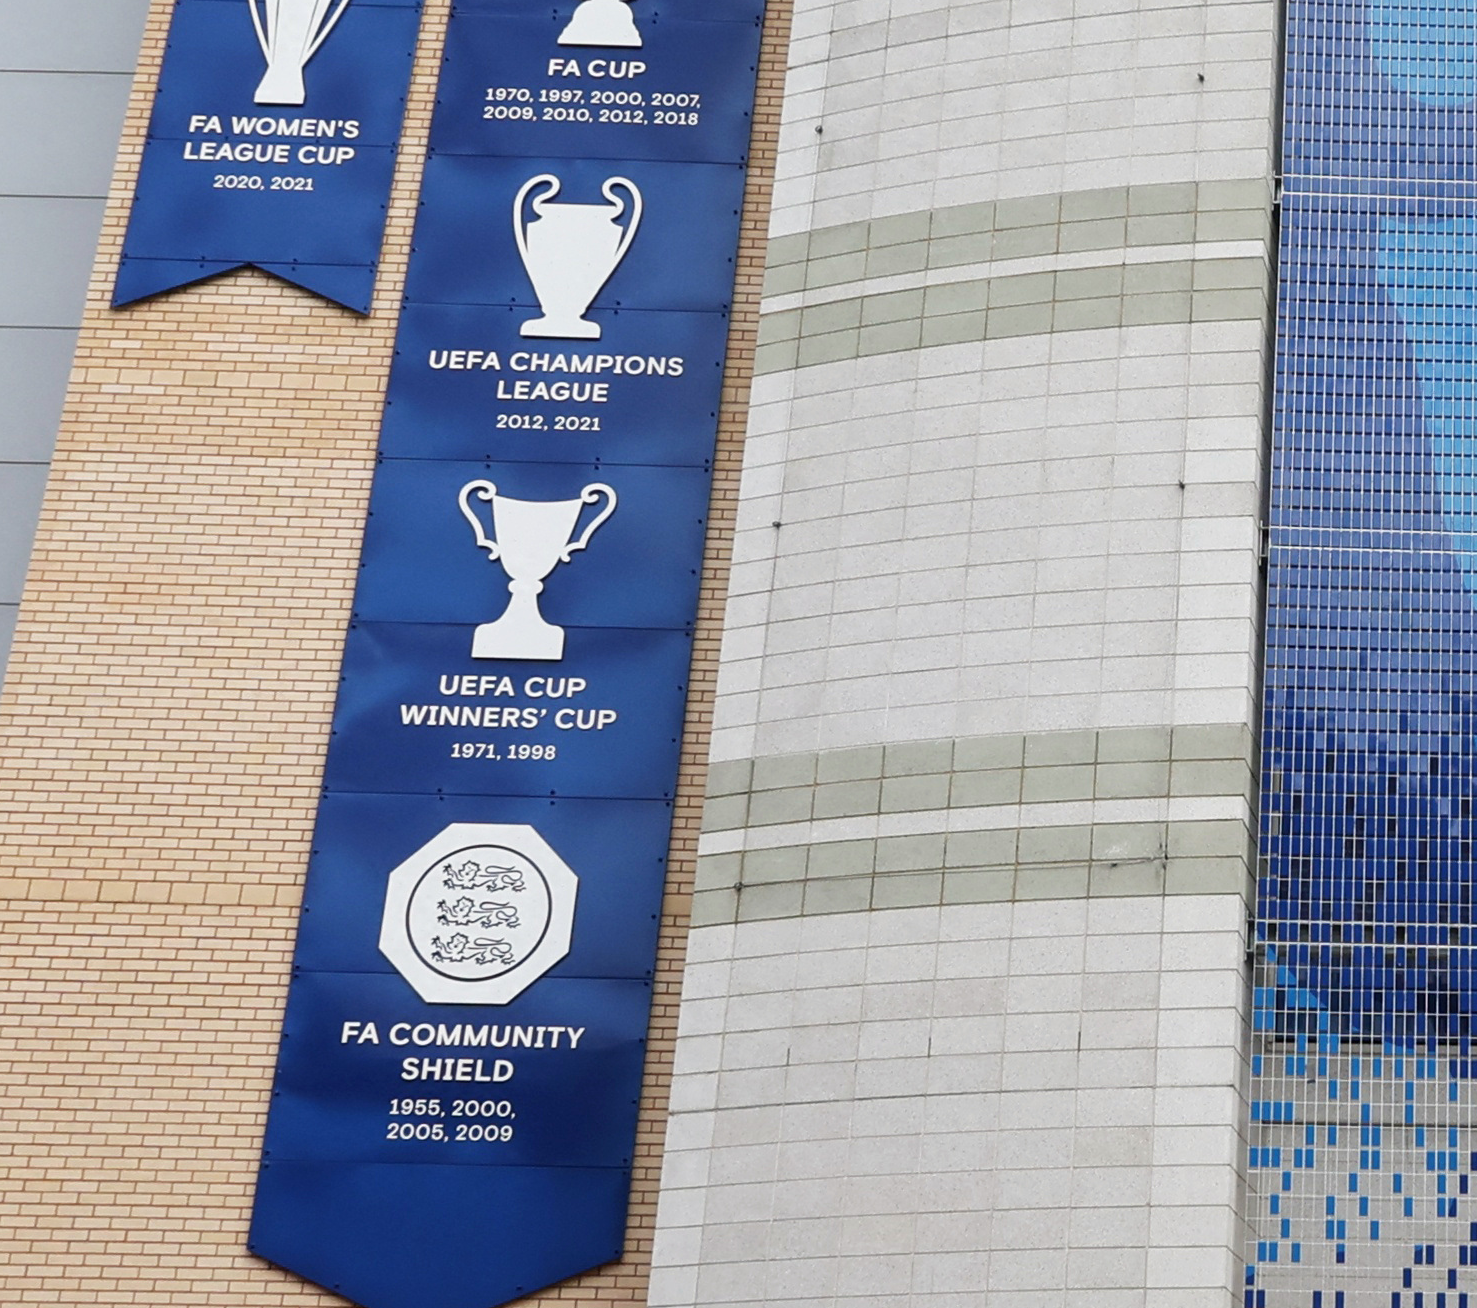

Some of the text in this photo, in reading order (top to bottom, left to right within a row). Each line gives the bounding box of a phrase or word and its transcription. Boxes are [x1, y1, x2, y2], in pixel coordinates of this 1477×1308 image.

[547, 58, 647, 79] FA CUP
[485, 87, 701, 109] 1970, 1997, 2000, 2007,
[188, 114, 360, 139] FA WOMEN'S
[482, 105, 699, 126] 2009, 2010, 2012, 2018
[183, 141, 355, 165] LEAGUE CUP
[212, 174, 314, 191] 2020, 2021
[429, 349, 684, 376] UEFA CHAMPIONS
[496, 380, 610, 402] LEAGUE
[495, 414, 601, 431] 2012, 2021
[439, 674, 587, 698] UEFA CUP
[554, 708, 617, 730] CUP
[450, 742, 556, 761] 1971, 1998
[341, 1021, 586, 1049] FA COMMUNITY
[401, 1057, 514, 1082] SHIELD
[389, 1098, 516, 1119] 1955, 2000,
[386, 1122, 513, 1143] 2005, 2009
